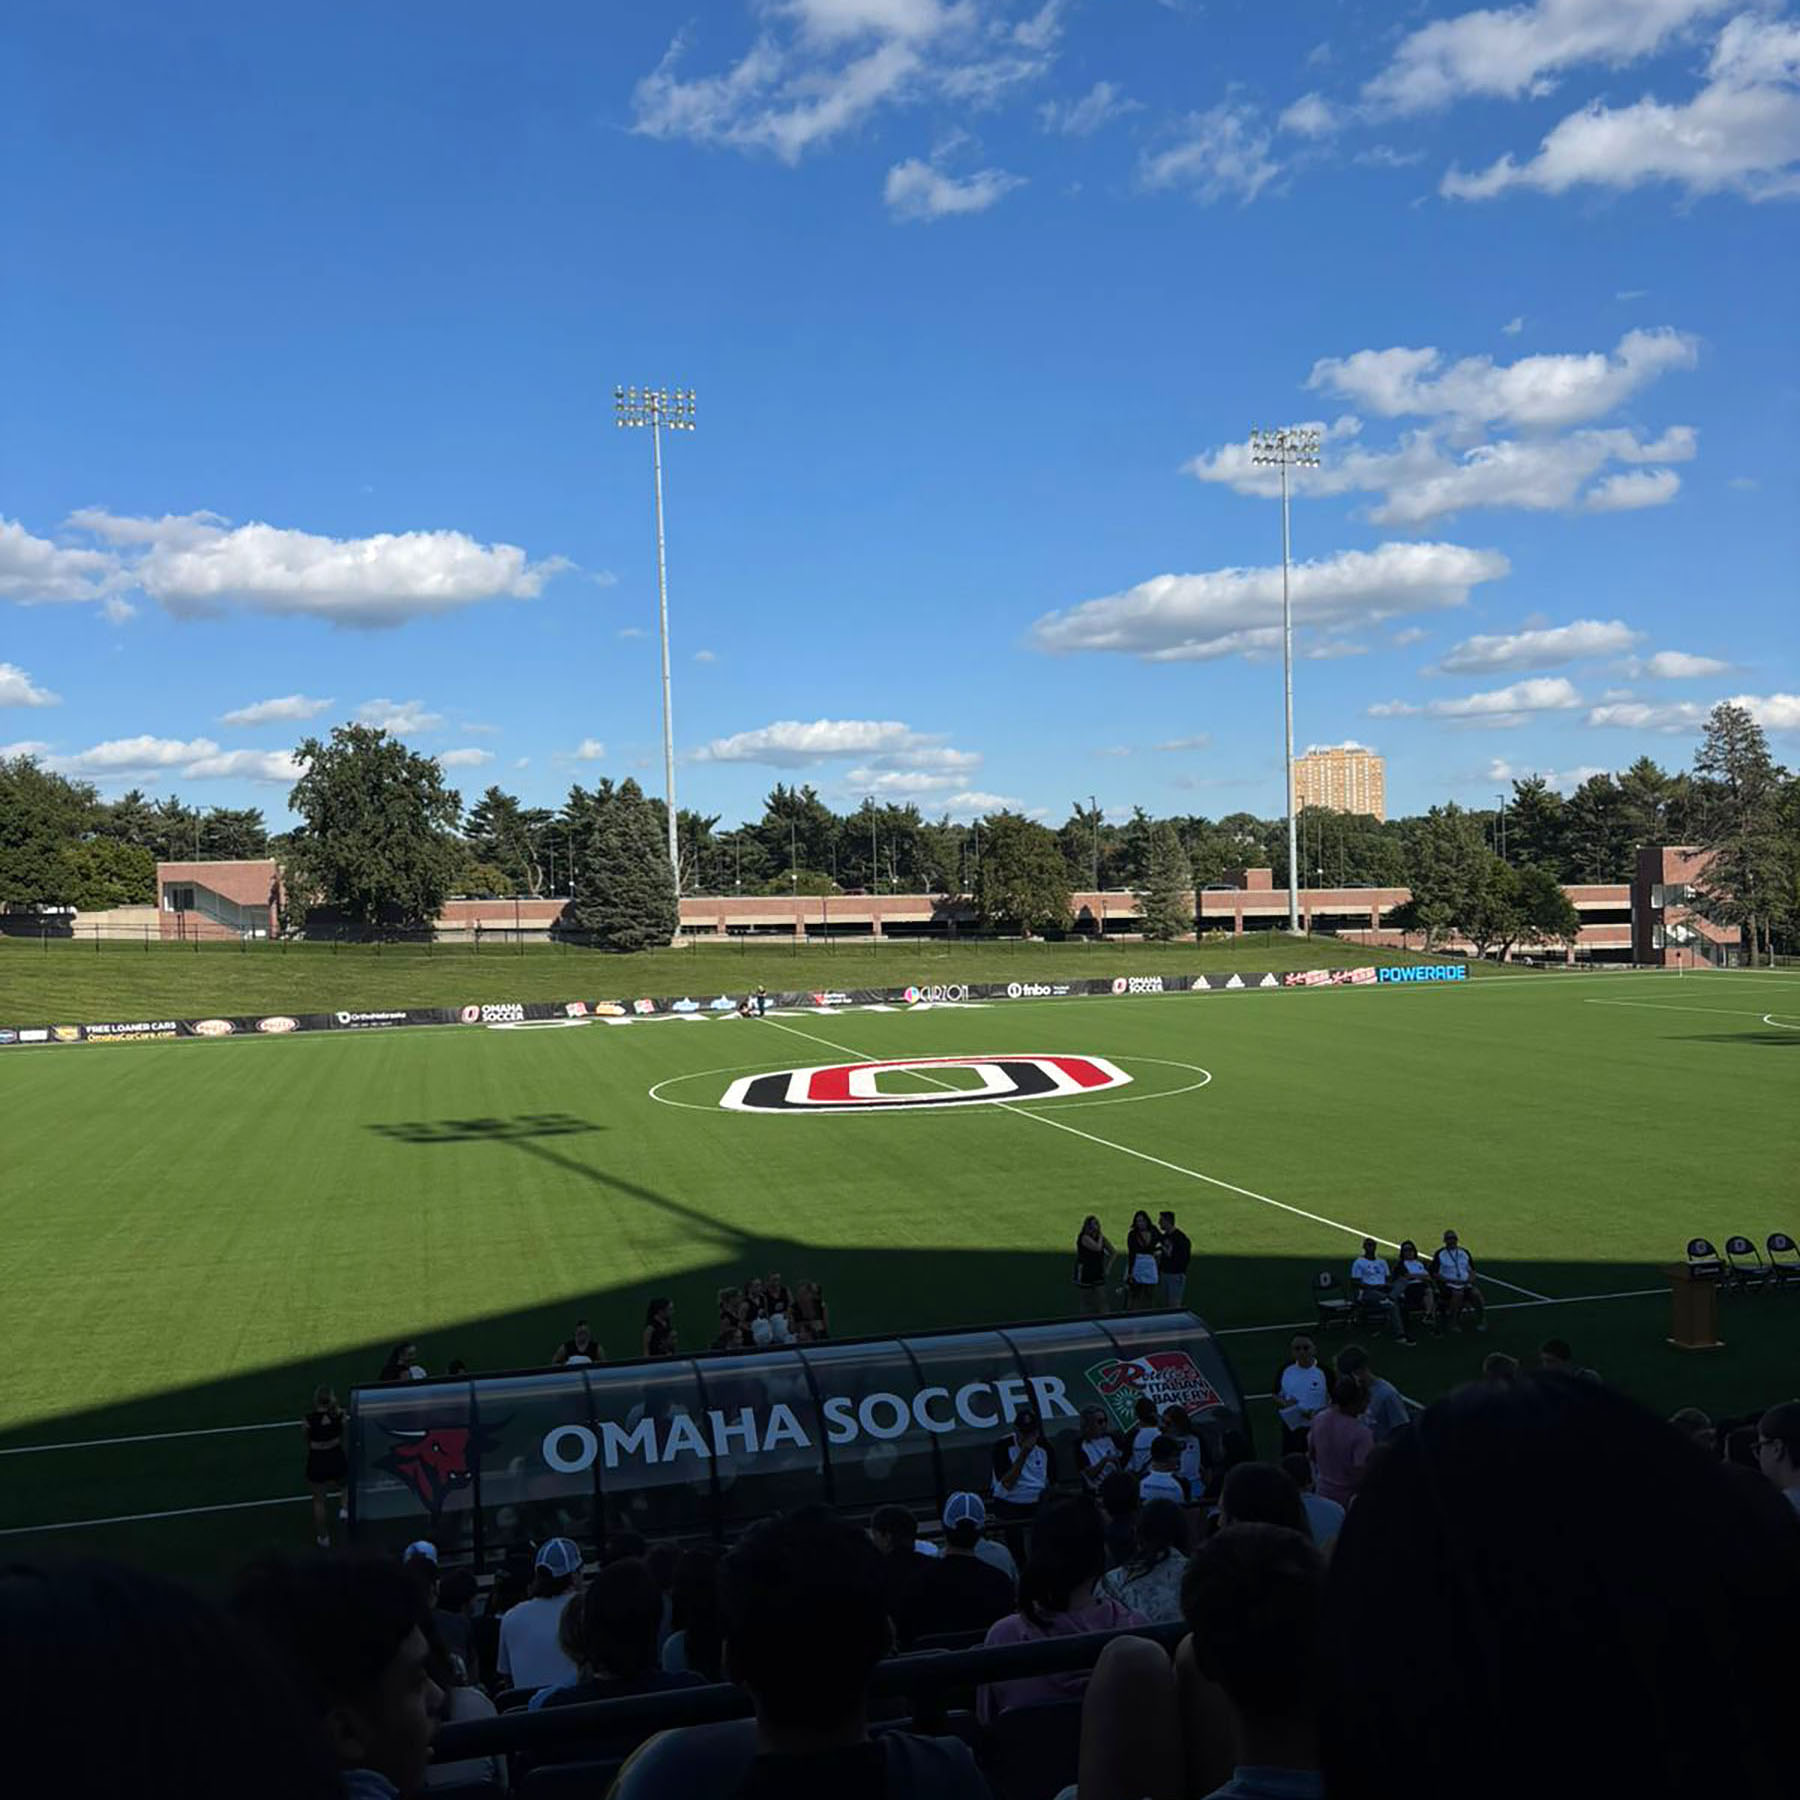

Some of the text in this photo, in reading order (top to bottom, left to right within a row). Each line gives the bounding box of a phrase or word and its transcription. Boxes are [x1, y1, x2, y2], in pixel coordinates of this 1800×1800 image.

[1380, 966, 1465, 981] POWERADE
[1023, 983, 1051, 996] fnbo
[481, 1004, 523, 1014] OMAHA
[87, 1021, 176, 1033] FREE LOANER CARS
[1149, 1378, 1209, 1394] ITALIAN
[1152, 1389, 1209, 1404] BAKERY
[542, 1375, 1079, 1474] OMAHA SOCCER
